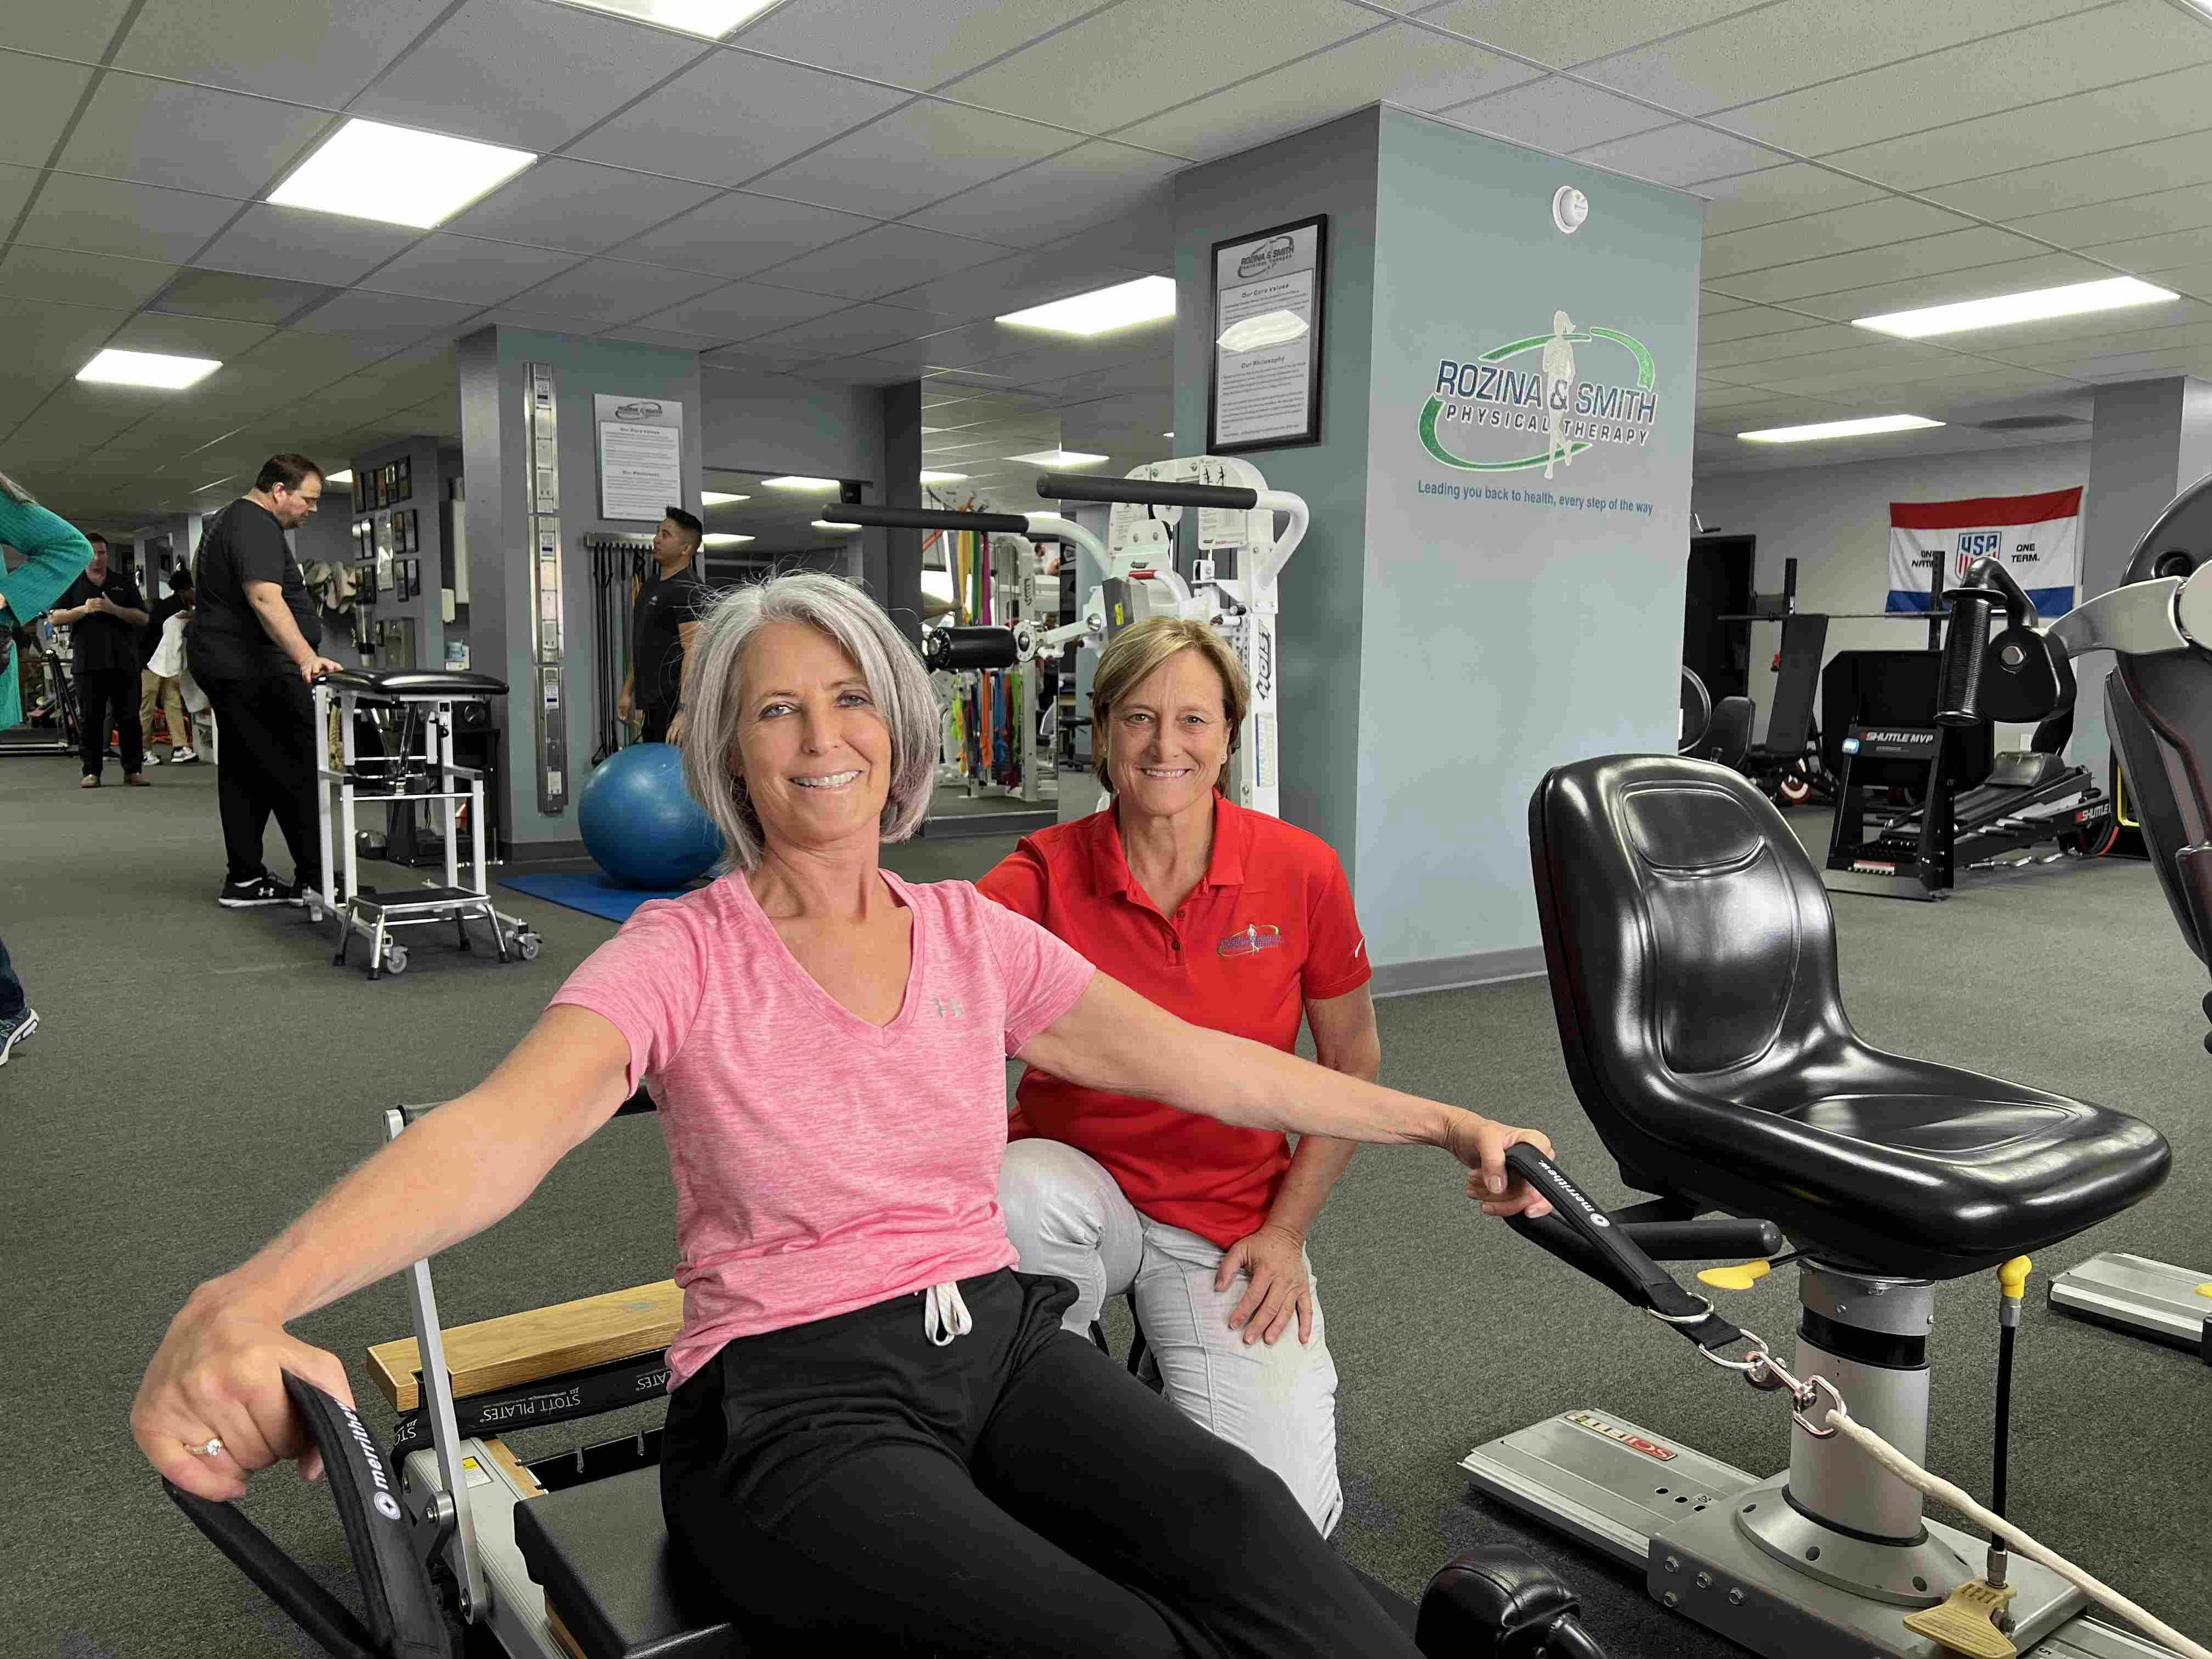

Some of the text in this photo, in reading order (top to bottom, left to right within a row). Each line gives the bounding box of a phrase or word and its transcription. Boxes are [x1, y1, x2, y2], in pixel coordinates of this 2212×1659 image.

[1435, 359, 1656, 424] ROZINA & SMITH
[1446, 405, 1649, 445] PHYSICAL THERAPY
[1418, 478, 1653, 516] Leading you back to health, every step of the way
[1921, 550, 1934, 558] ON
[1961, 535, 1997, 556] USA
[2016, 543, 2035, 552] ONE
[2011, 552, 2040, 563] TEAM.
[1866, 731, 1934, 743] SHUTTLE MVP
[540, 1394, 580, 1412] STOTT
